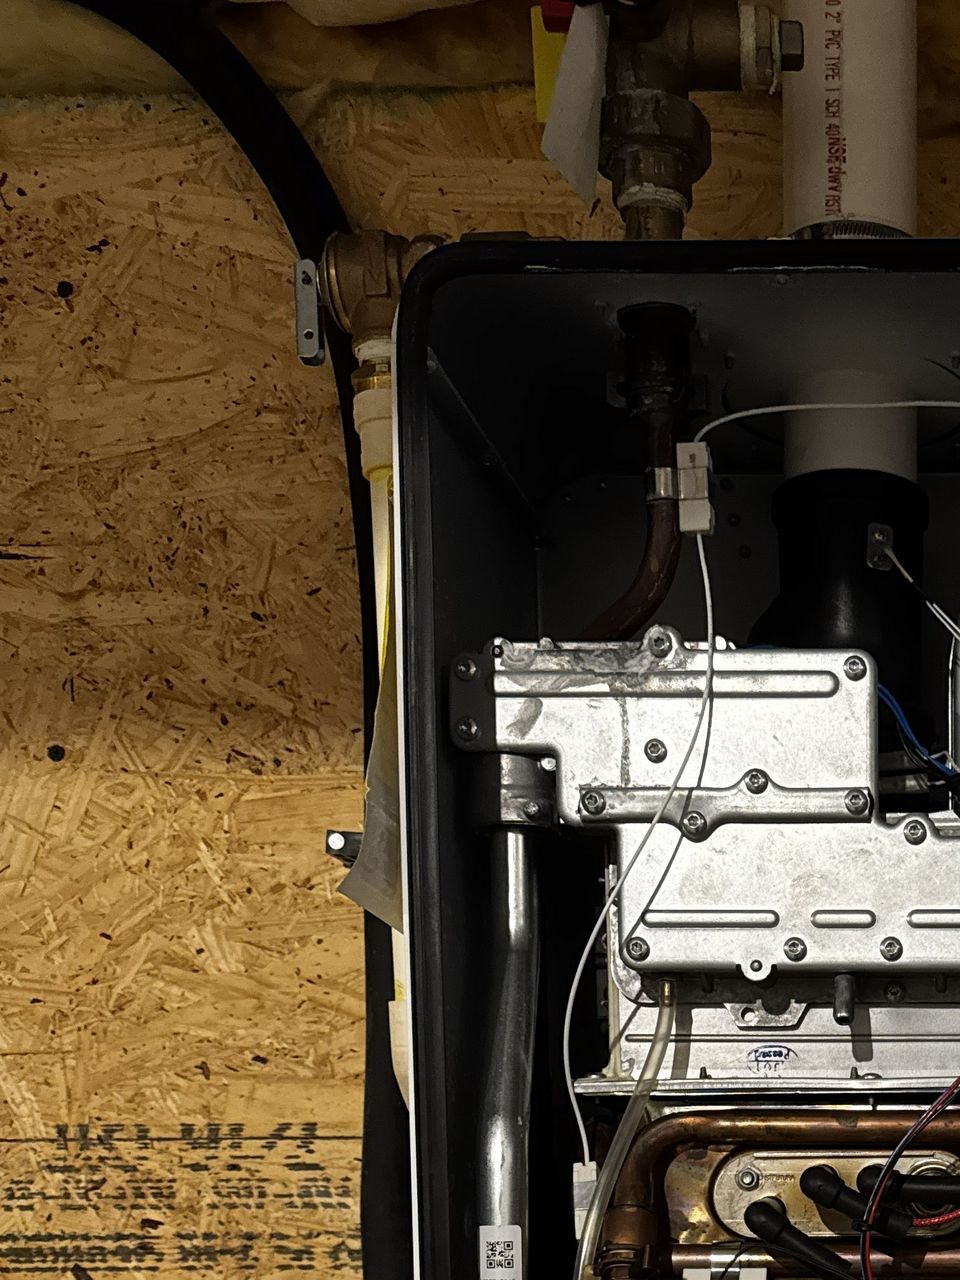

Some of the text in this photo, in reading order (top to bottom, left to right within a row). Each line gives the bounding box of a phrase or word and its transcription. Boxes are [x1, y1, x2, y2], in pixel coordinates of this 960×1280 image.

[825, 30, 841, 50] PVC
[825, 56, 841, 81] TYPE
[825, 98, 840, 118] SCH
[825, 123, 841, 136] 40
